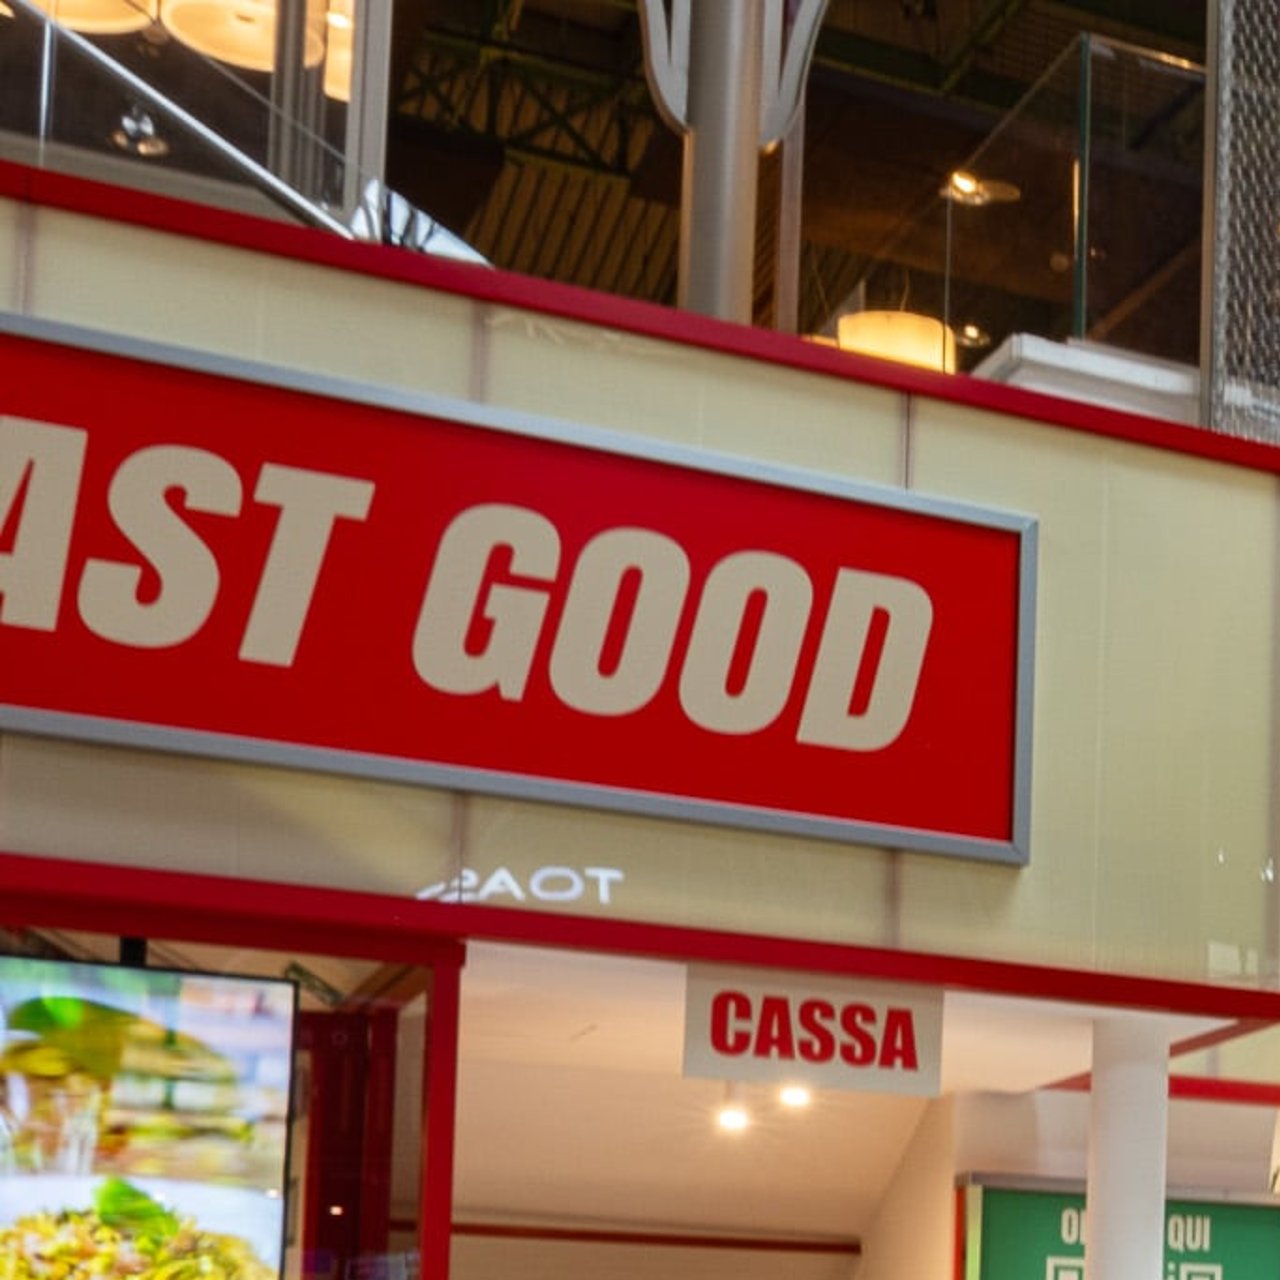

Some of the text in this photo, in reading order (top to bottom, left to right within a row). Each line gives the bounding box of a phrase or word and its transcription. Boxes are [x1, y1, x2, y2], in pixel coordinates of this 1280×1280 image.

[411, 503, 934, 752] GOOD
[710, 988, 919, 1072] CASSA
[1168, 1214, 1211, 1253] QUI
